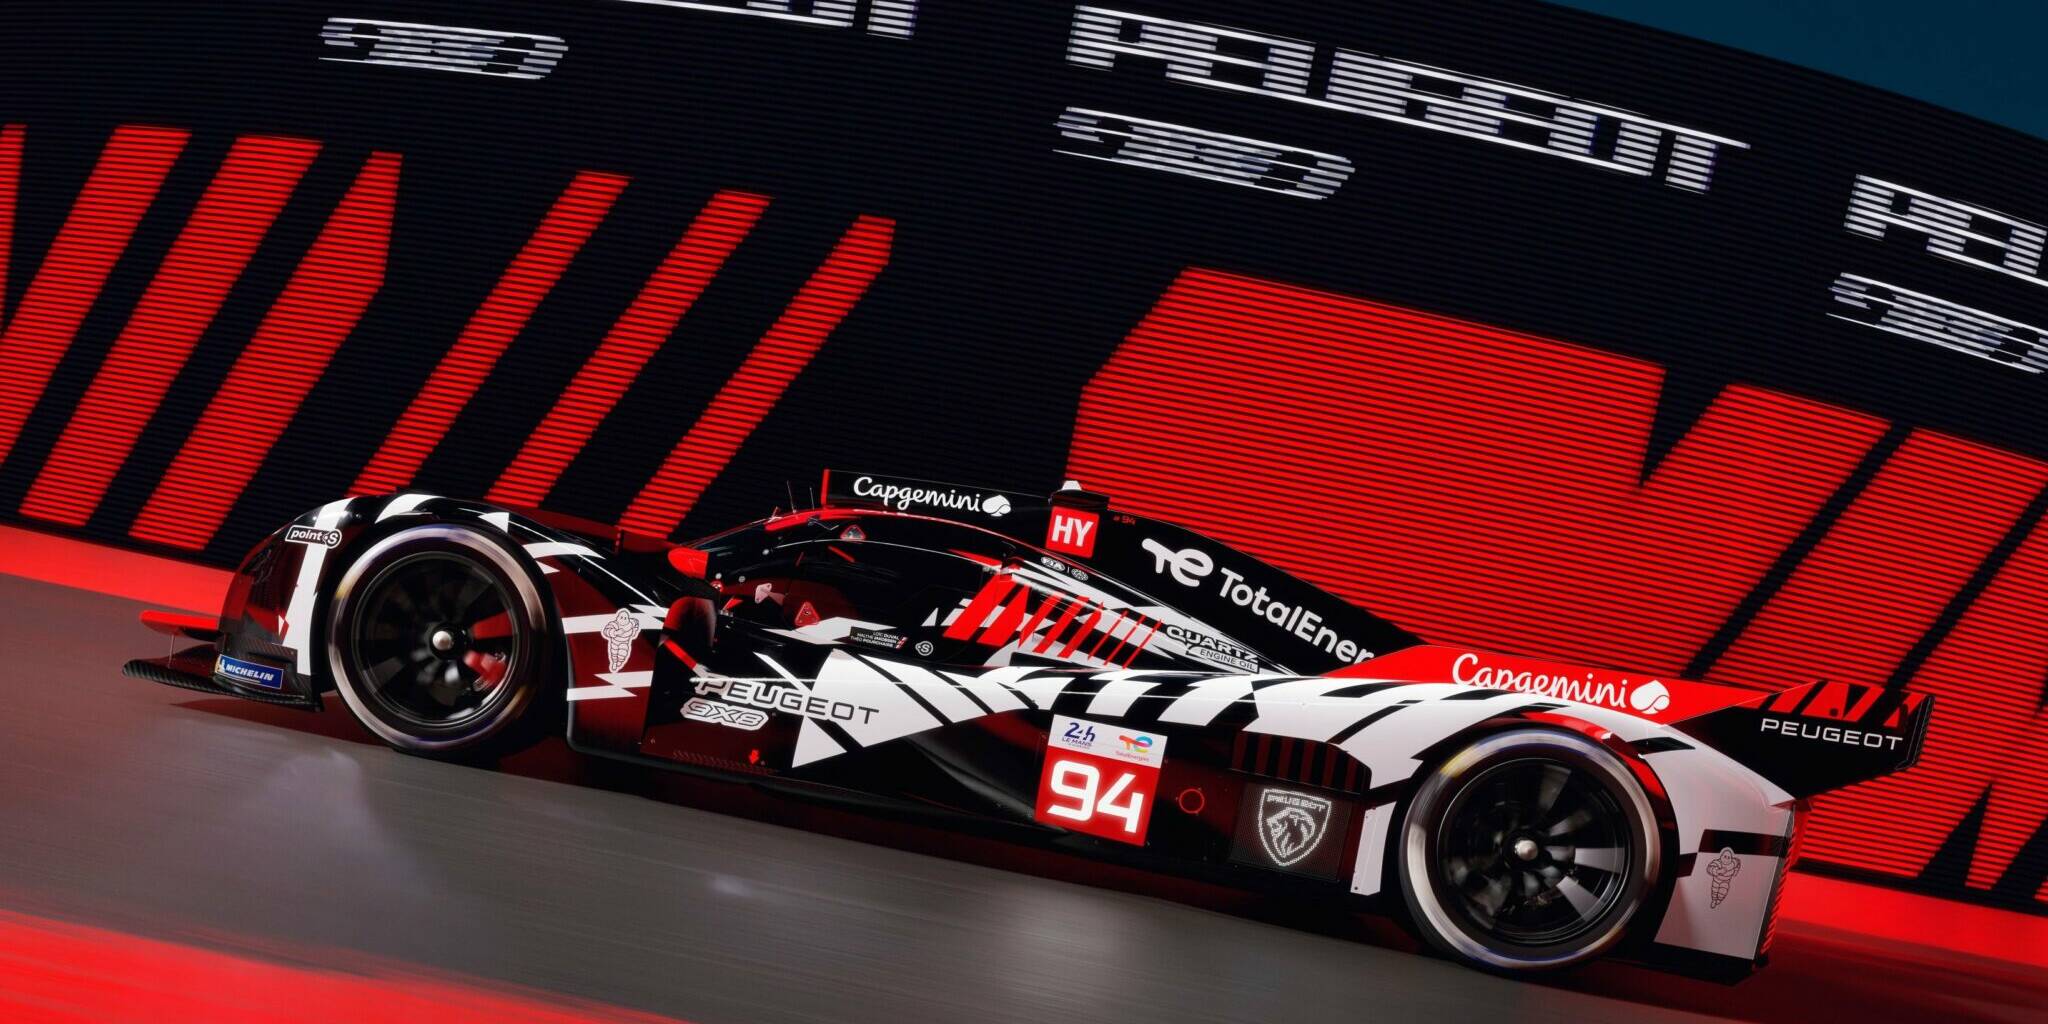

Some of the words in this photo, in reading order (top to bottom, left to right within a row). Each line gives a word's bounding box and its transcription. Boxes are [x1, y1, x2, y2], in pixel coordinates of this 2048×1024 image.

[1066, 4, 1751, 194] PEUGEOT
[853, 476, 981, 511] Capgemini
[290, 529, 323, 541] point
[1051, 514, 1094, 548] HY
[1165, 624, 1259, 663] QUARTZ
[1200, 648, 1237, 665] ENGINE
[1239, 660, 1256, 671] OIL
[225, 663, 275, 681] MICHELIN
[685, 698, 766, 729] 9X8
[697, 675, 880, 725] PEUGEOT
[1760, 717, 1904, 750] PEUGEOT
[1046, 760, 1144, 834] 94
[1267, 794, 1326, 812] PEUGEOT
